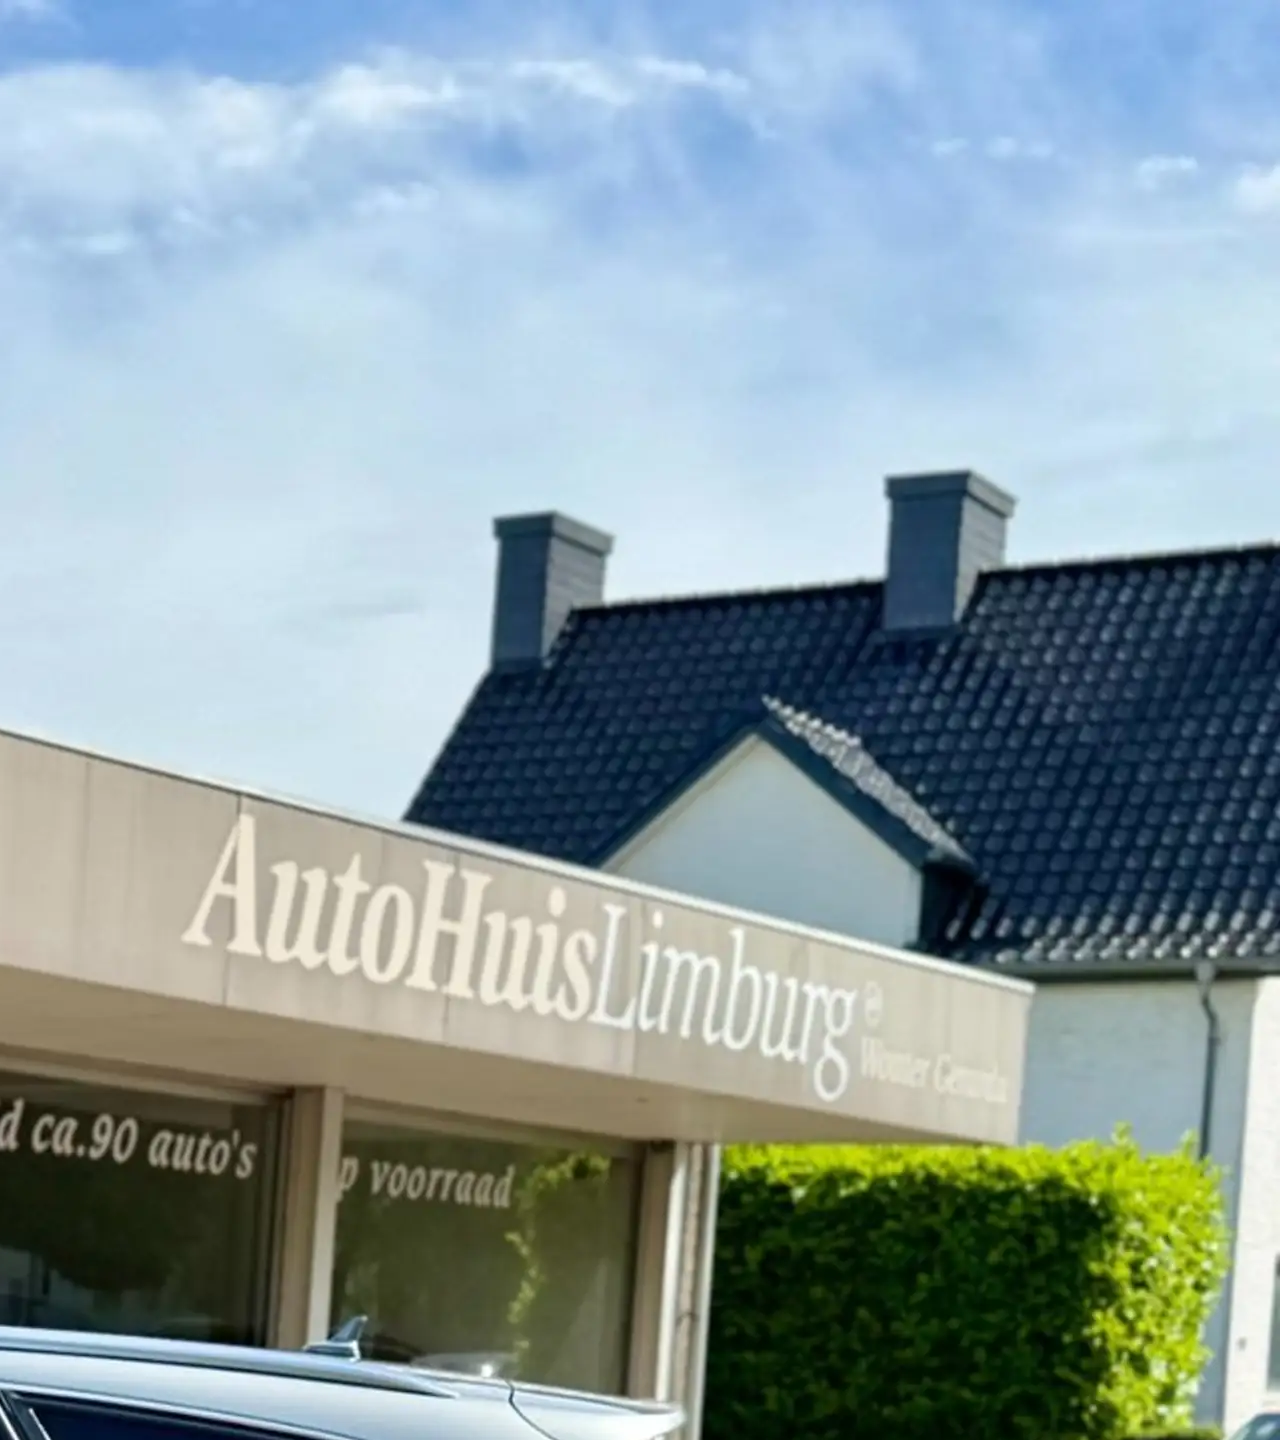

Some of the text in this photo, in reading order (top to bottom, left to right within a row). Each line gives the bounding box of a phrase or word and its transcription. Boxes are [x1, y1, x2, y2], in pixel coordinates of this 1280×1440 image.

[180, 812, 861, 1102] AutoHuisLimburg
[31, 1113, 139, 1164] ca.90
[147, 1129, 258, 1179] auto's
[370, 1159, 517, 1208] voorraad
